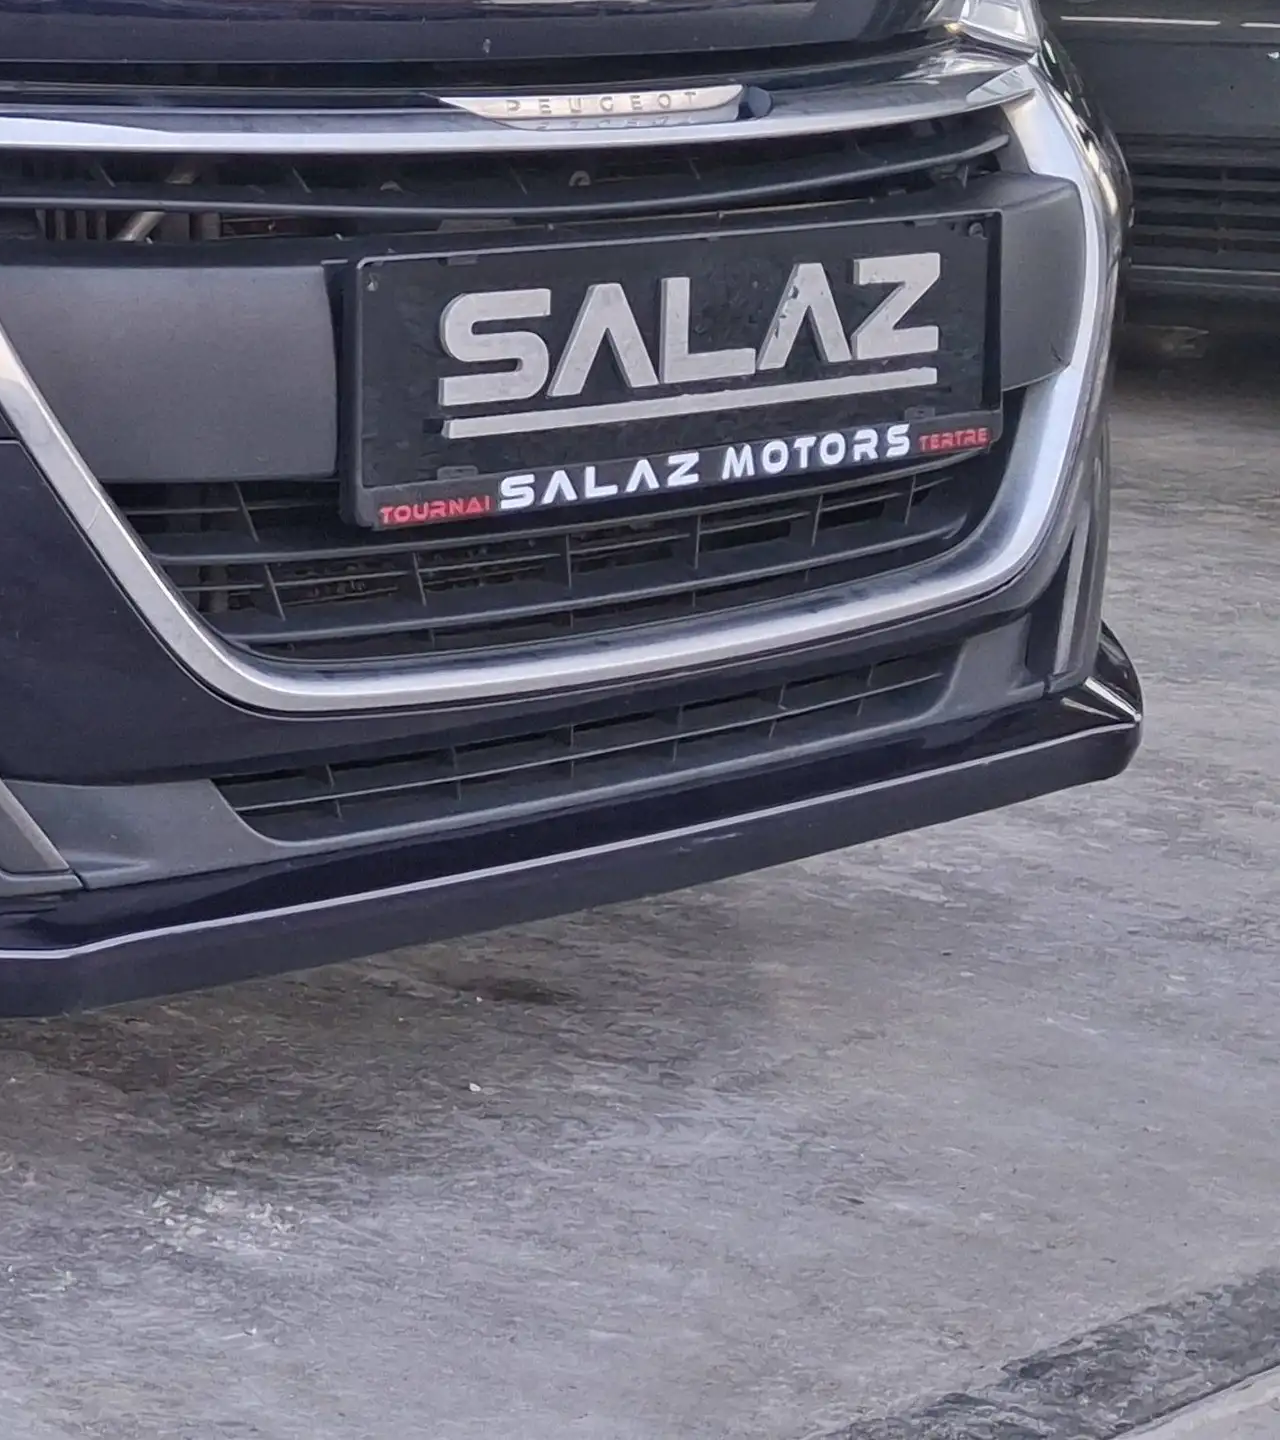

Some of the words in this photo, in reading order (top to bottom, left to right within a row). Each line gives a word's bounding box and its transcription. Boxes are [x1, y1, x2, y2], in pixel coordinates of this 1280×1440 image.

[505, 90, 697, 115] PEUGEOT
[440, 252, 941, 407] SALAZ
[379, 495, 491, 525] TOURNAI
[499, 452, 700, 510] SALAZ
[721, 422, 911, 481] MOTORS
[919, 427, 989, 453] TERTRE
